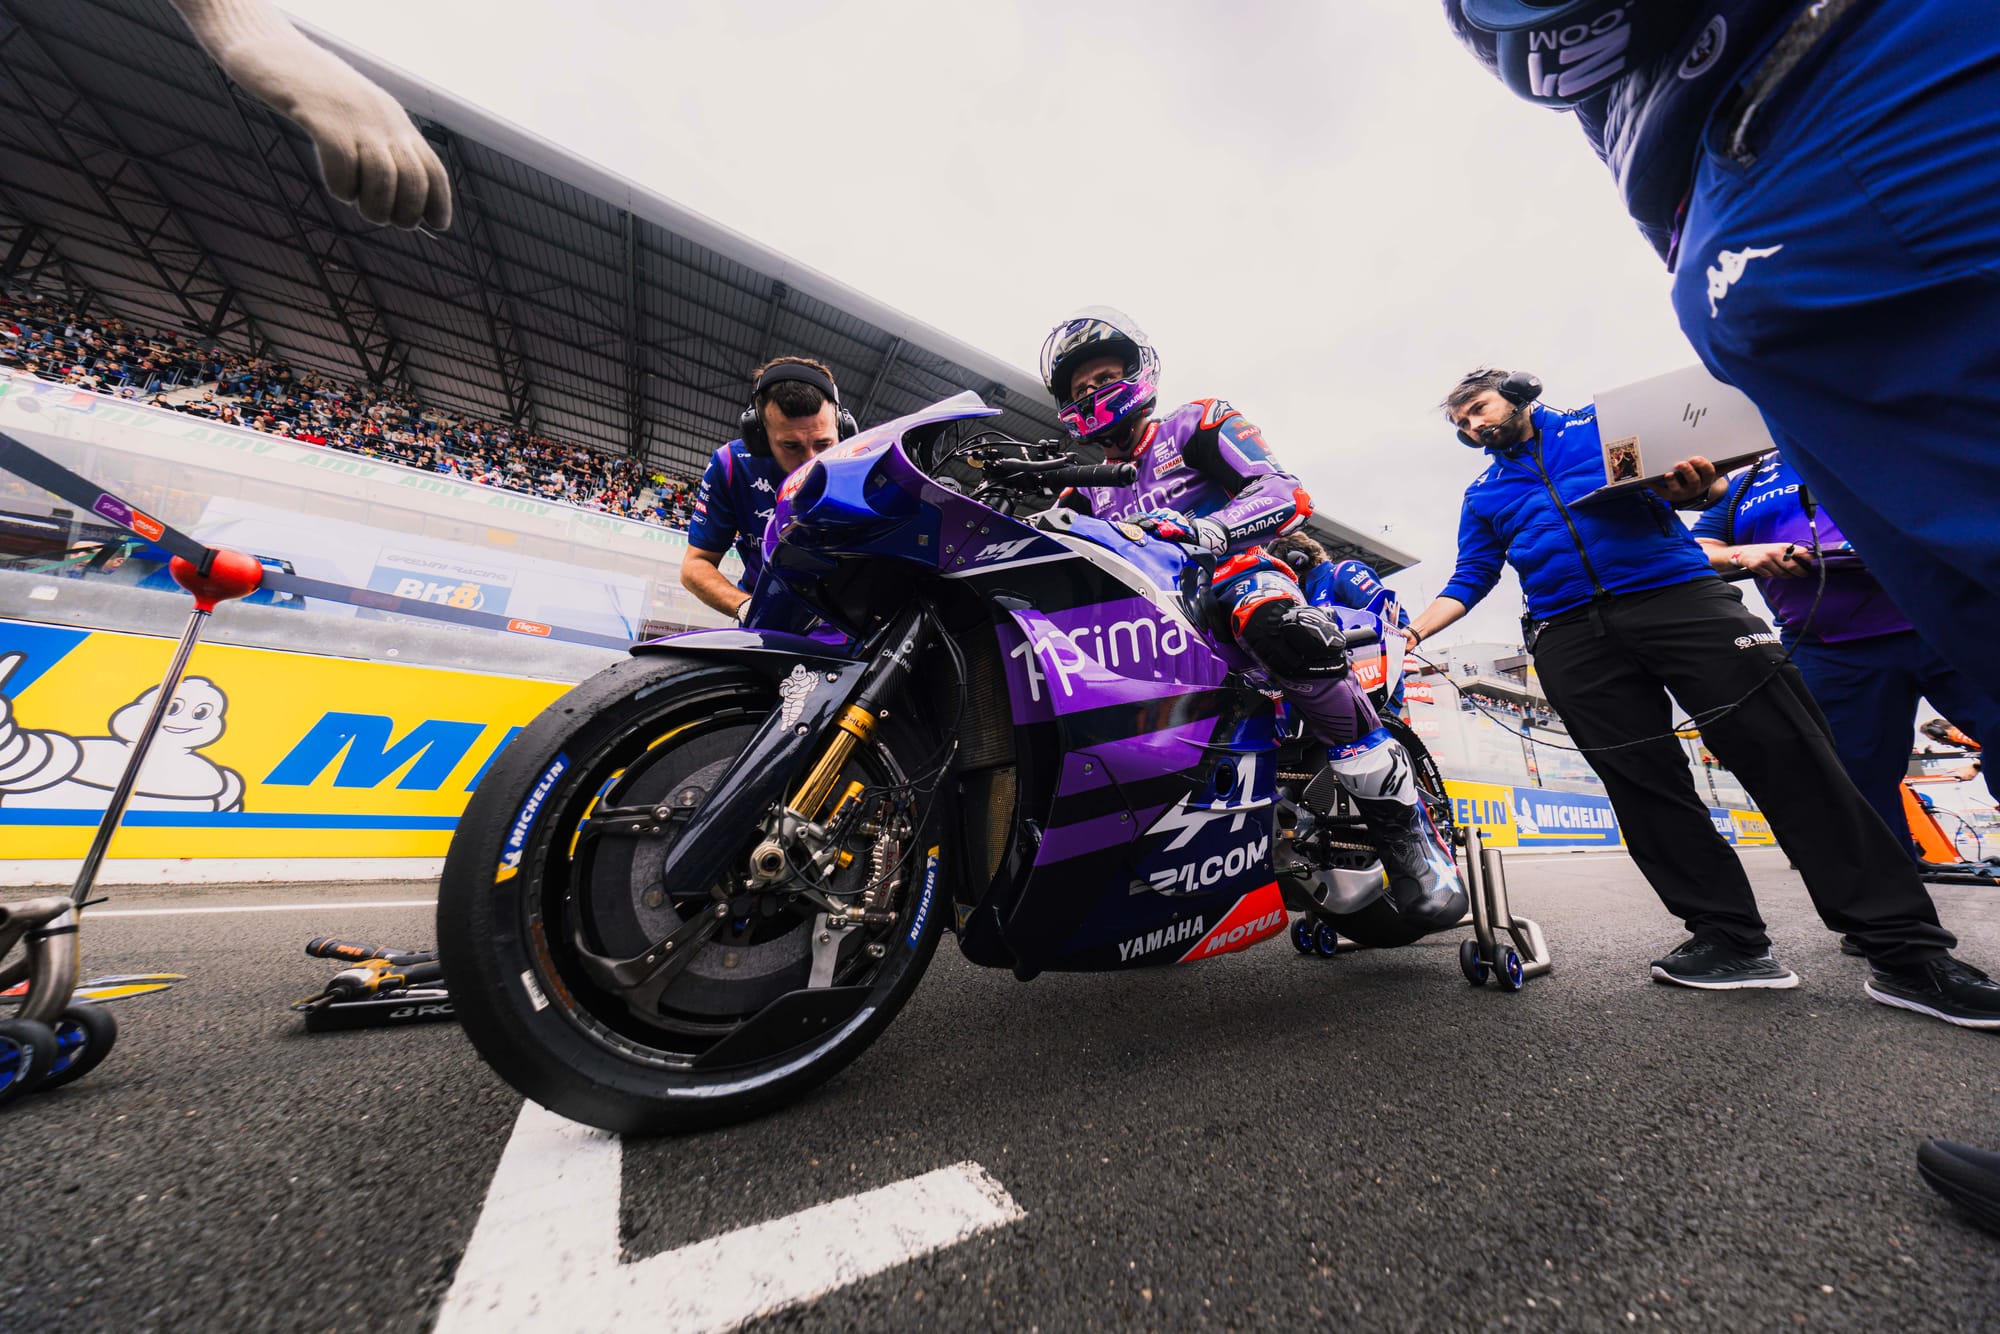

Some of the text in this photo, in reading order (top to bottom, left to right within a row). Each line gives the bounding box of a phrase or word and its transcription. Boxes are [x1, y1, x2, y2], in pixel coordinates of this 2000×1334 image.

[1119, 387, 1148, 414] PRAMAC
[1227, 496, 1273, 522] prima
[1740, 483, 1799, 516] prima
[1230, 511, 1285, 539] PRAMAC
[509, 761, 564, 847] MICHELIN
[1535, 804, 1614, 829] MICHELIN
[910, 871, 935, 940] MICHELIN
[1118, 915, 1204, 962] YAMAHA
[1204, 908, 1282, 954] MOTUL
